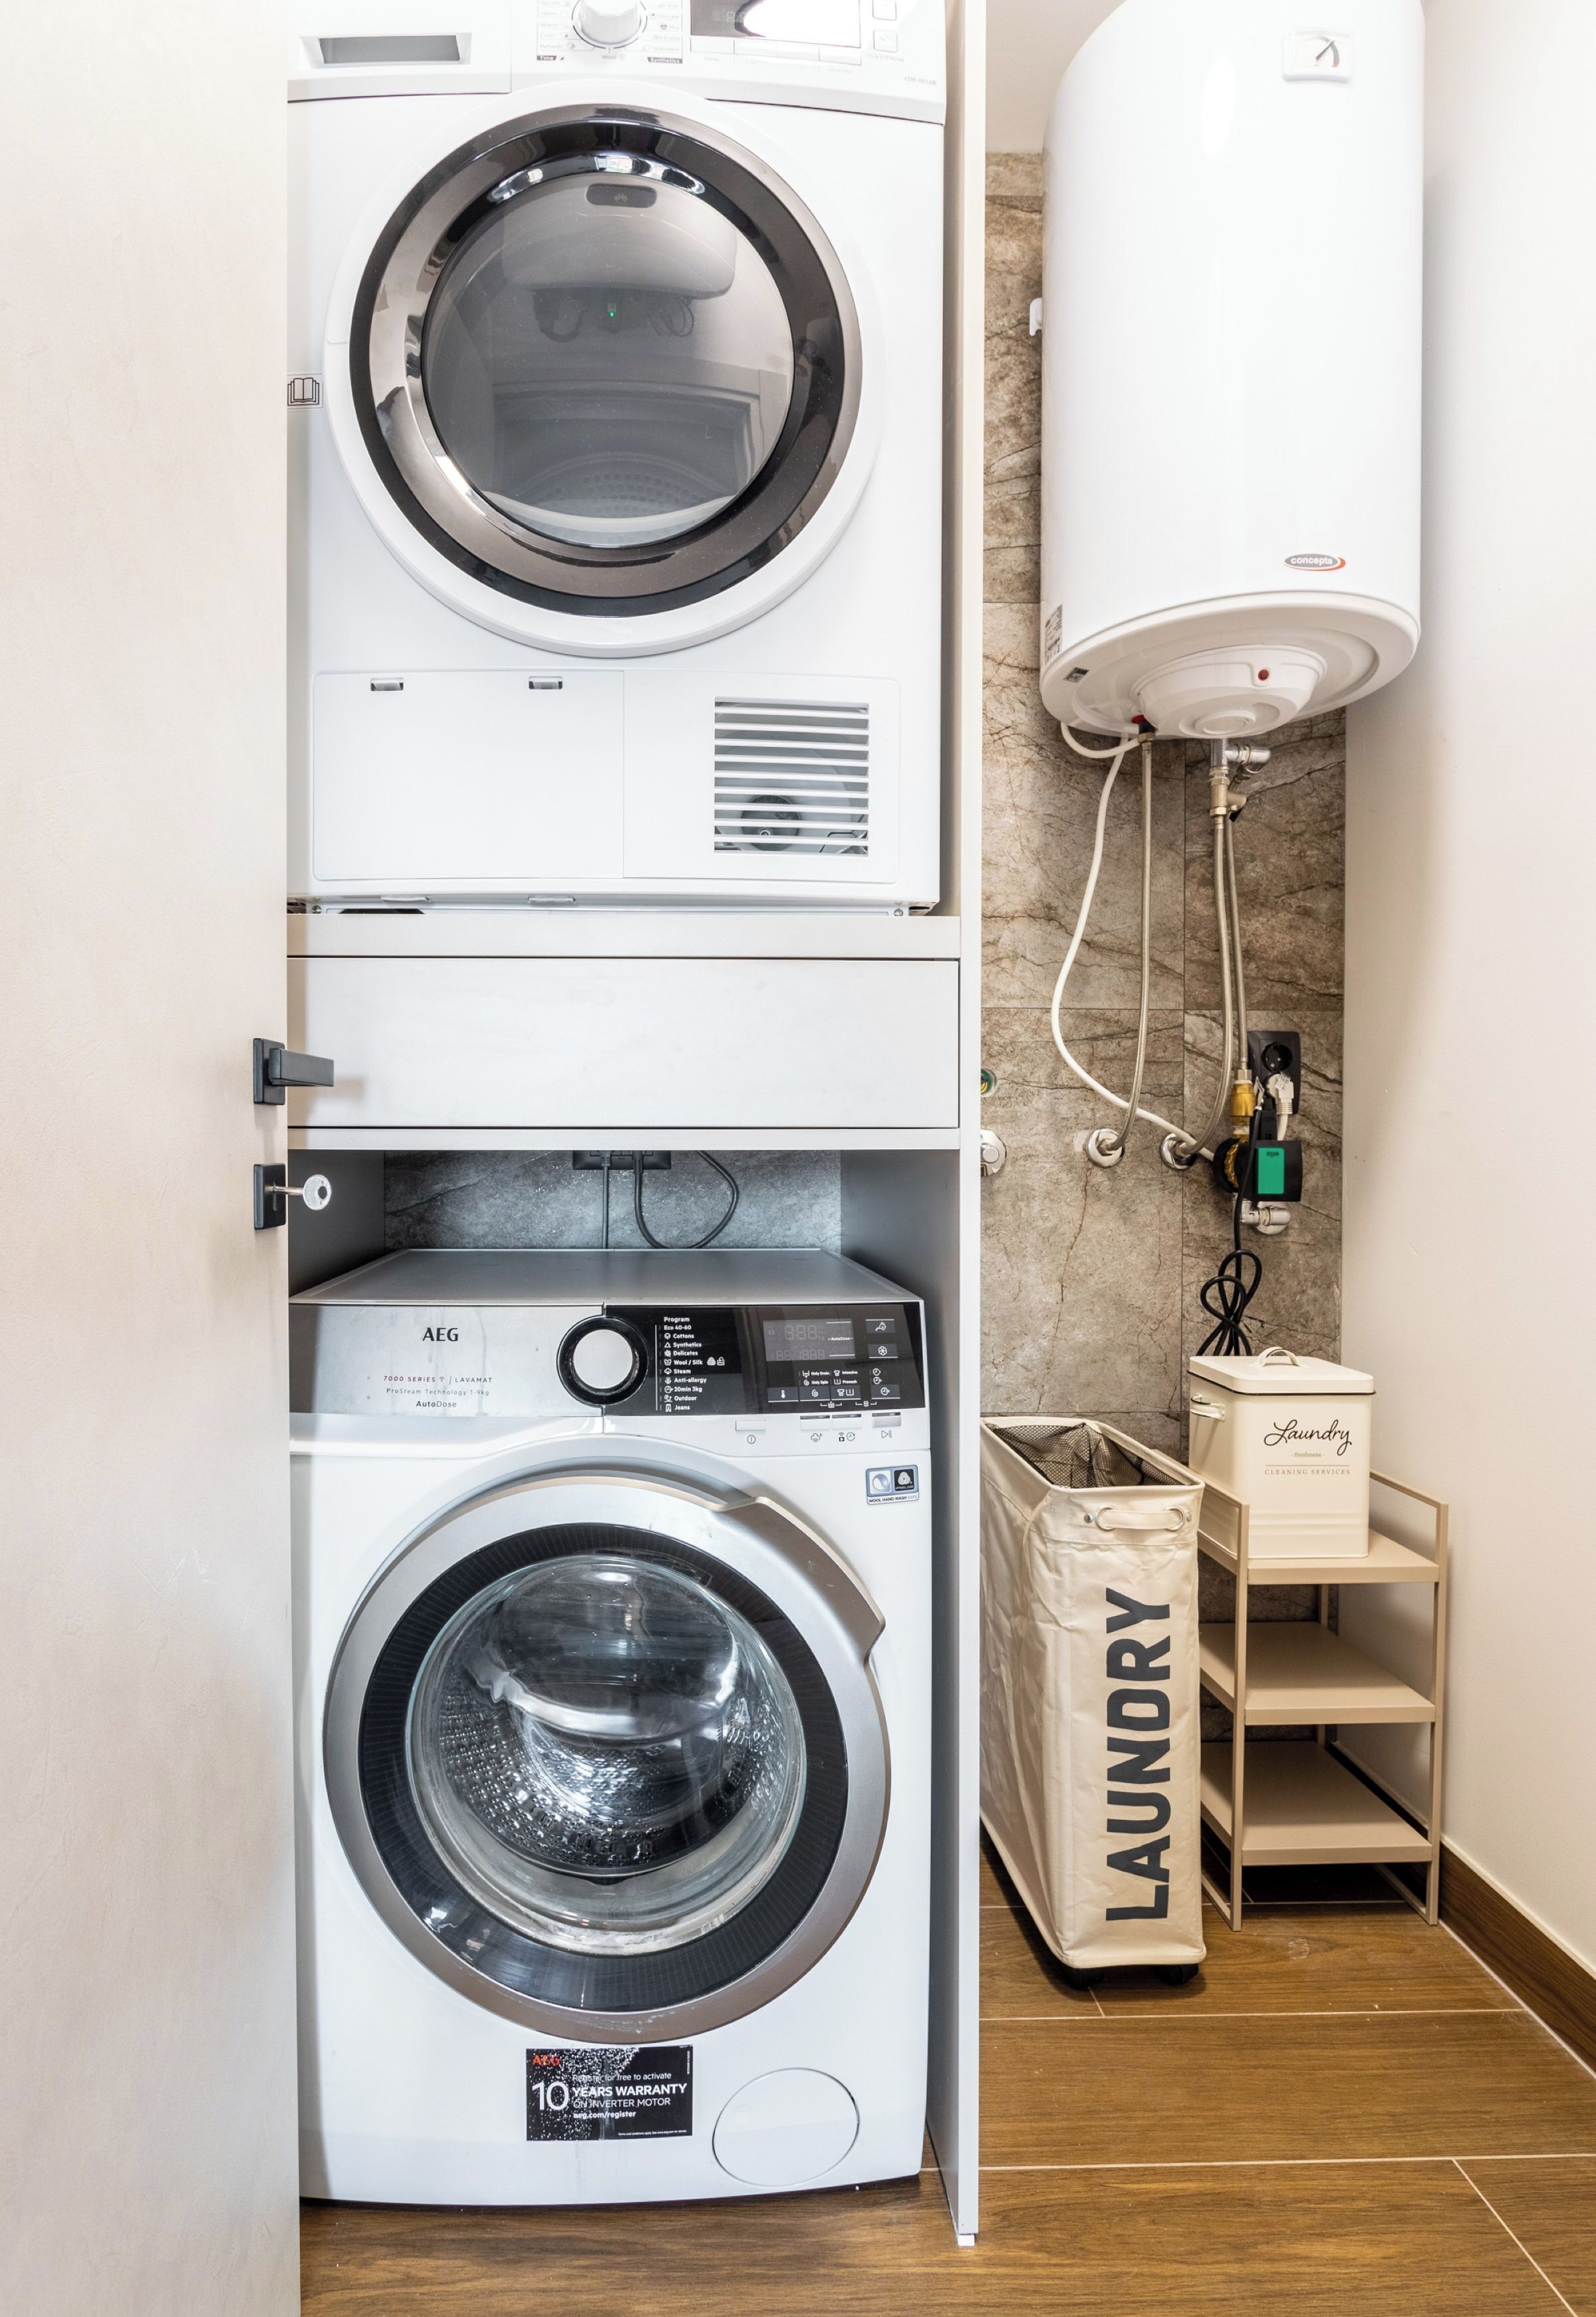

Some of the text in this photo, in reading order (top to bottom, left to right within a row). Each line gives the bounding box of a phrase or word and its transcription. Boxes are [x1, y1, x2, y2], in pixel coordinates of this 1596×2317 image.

[1290, 557, 1333, 566] concepta
[422, 1327, 459, 1342] AEG
[1264, 1419, 1352, 1456] Laundry
[1105, 1587, 1172, 1921] LAUNDRY
[532, 2054, 561, 2066] AEG
[573, 2074, 603, 2083] Register
[532, 2080, 688, 2111] 10 YEARS WARRANTY
[573, 2098, 671, 2108] ON INVERTER MOTOR
[573, 2110, 636, 2119] aeg.com/register
